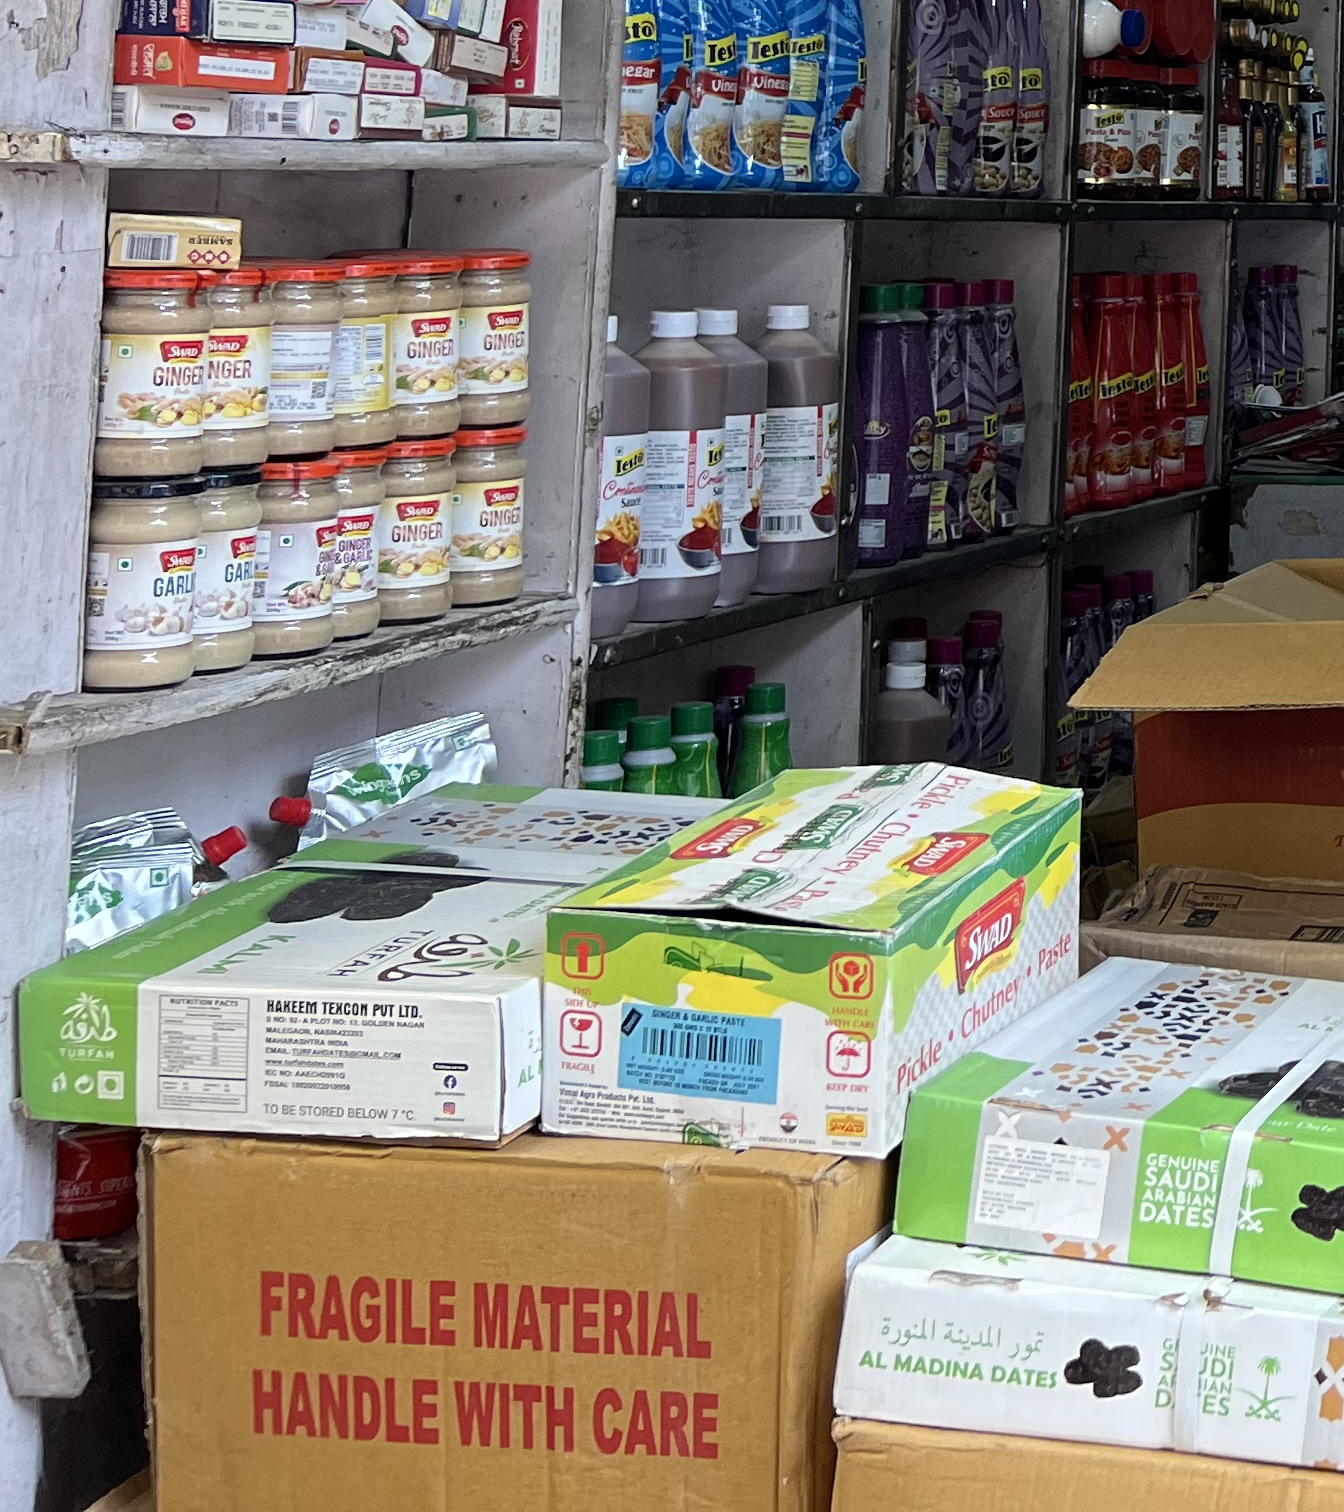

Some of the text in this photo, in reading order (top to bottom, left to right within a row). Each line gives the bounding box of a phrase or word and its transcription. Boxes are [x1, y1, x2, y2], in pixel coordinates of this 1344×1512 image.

[1095, 113, 1123, 127] Testo
[419, 320, 449, 335] SWAD
[494, 314, 521, 327] SWAD
[407, 339, 454, 359] GINGER
[484, 332, 526, 350] GINGER
[167, 342, 198, 361] SWAD
[615, 452, 644, 474] Testo
[480, 507, 521, 527] GINGER
[392, 522, 443, 543] GINGER
[339, 537, 371, 551] GINGER
[834, 774, 973, 876] Pickle Chutney
[700, 823, 755, 855] SWAD
[913, 835, 966, 869] SWAD
[965, 913, 1013, 970] SWAD
[266, 1000, 422, 1018] HAKEEM PVT LTD.
[653, 1010, 745, 1027] GINGER GARLIC PASTE
[897, 933, 1072, 1094] Pickle Chutney Paste
[59, 1046, 114, 1059] TURFAH
[561, 1062, 595, 1074] FRAGILE
[264, 1104, 387, 1120] TO BE STORED BELOW
[1146, 1153, 1220, 1173] GENUINE
[1144, 1169, 1218, 1193] SAUDI
[1142, 1188, 1217, 1207] ARABIAN
[1139, 1203, 1215, 1228] DATES
[260, 1271, 712, 1359] FRAGILE MATERIAL
[859, 1351, 1058, 1389] AL MADINA DATES
[252, 1368, 719, 1459] HANDLE WITH CARE
